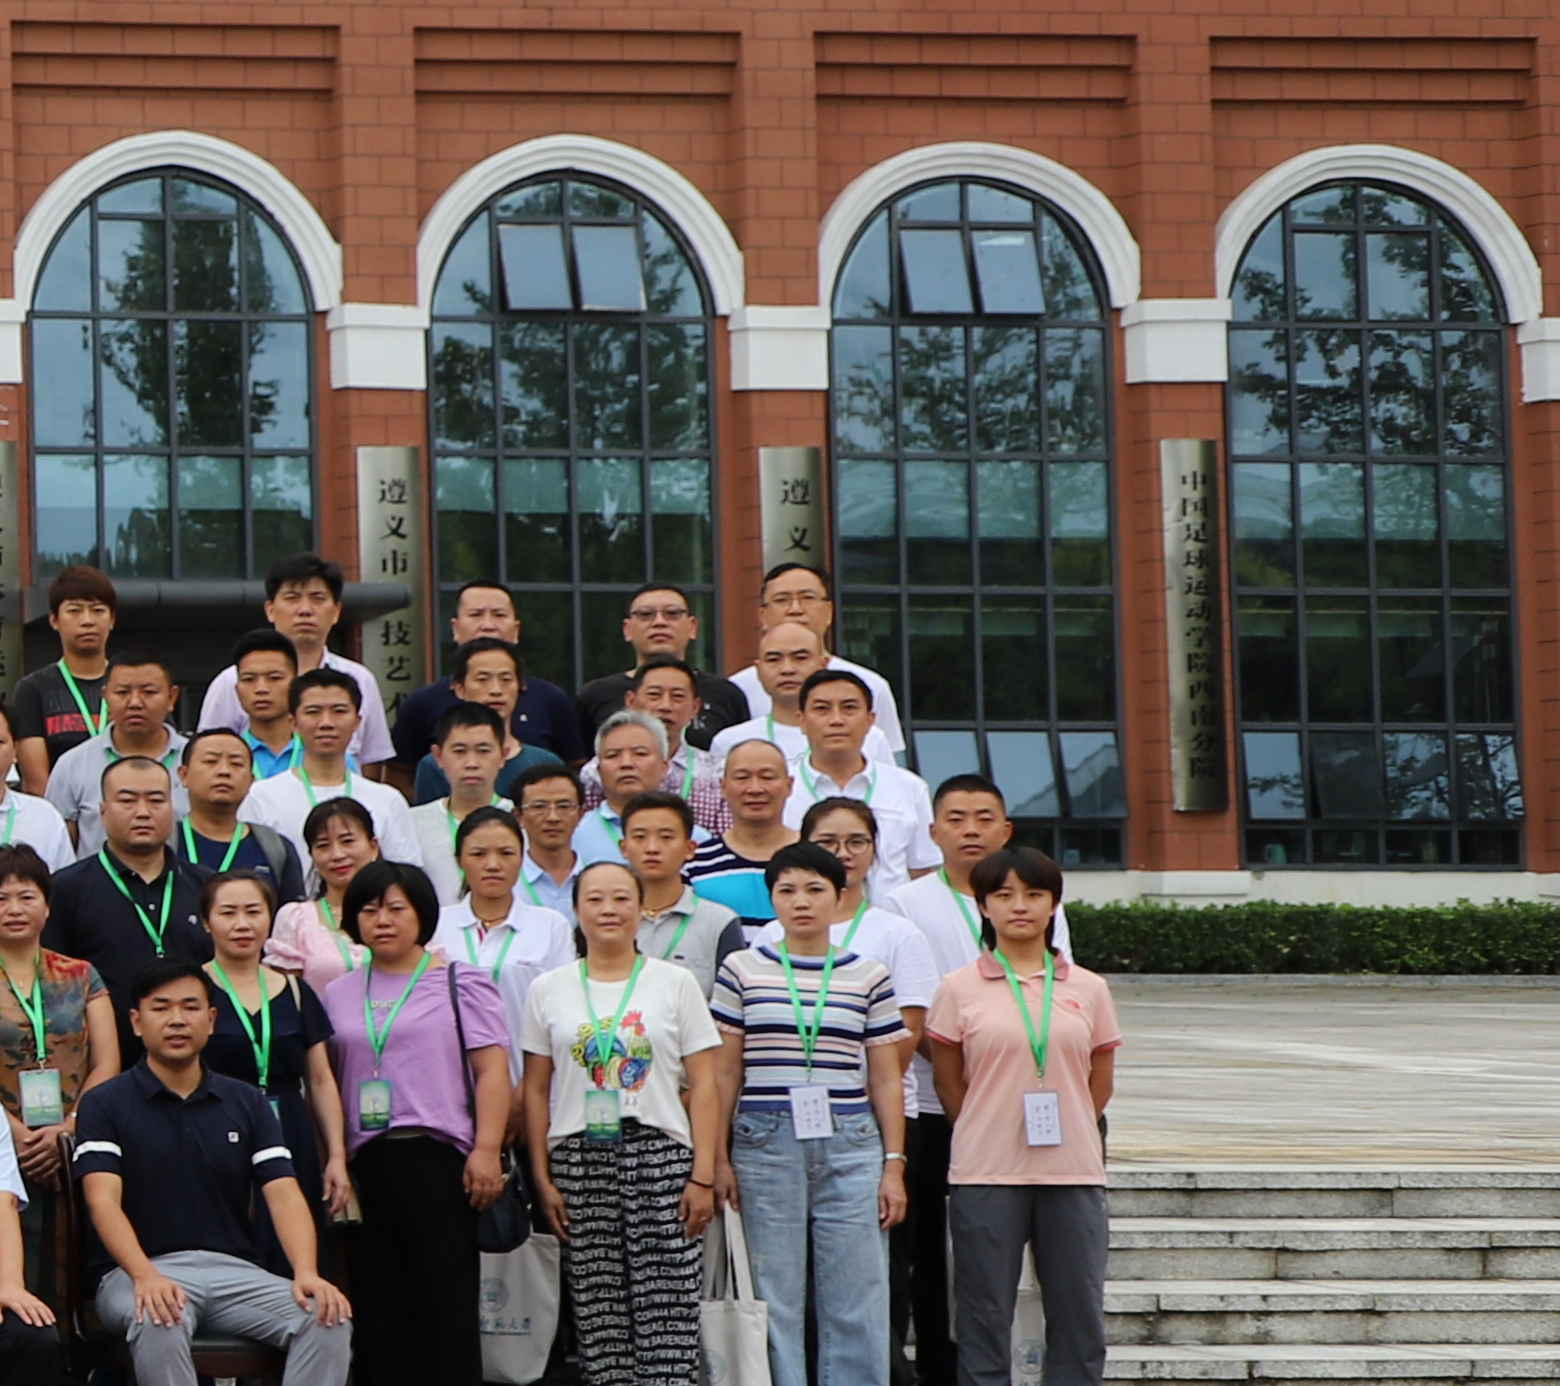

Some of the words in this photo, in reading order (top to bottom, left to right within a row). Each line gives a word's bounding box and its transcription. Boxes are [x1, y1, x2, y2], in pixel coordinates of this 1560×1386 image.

[780, 477, 812, 552] 遵义
[378, 478, 412, 715] 遵义市技艺术
